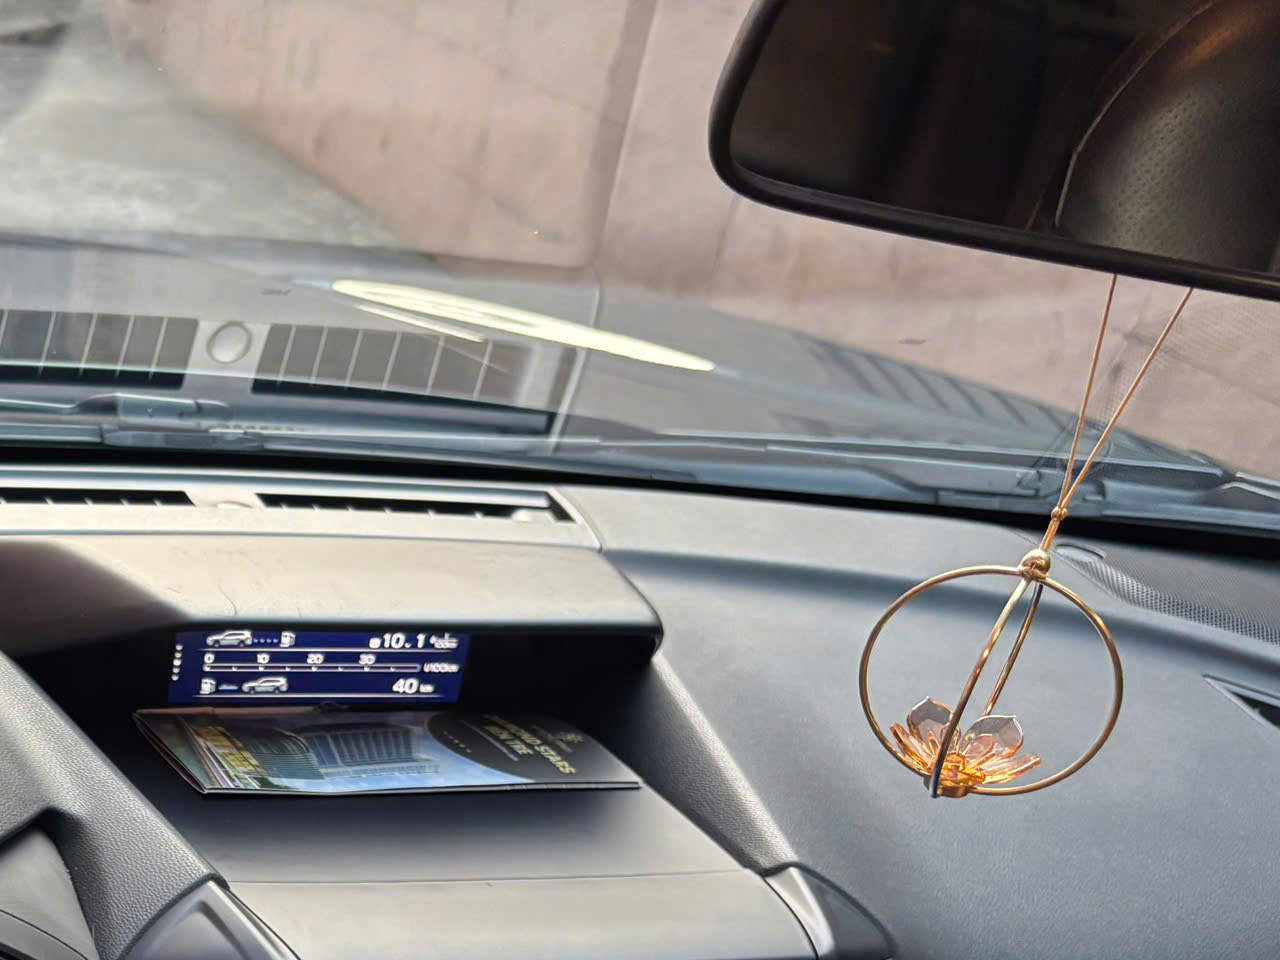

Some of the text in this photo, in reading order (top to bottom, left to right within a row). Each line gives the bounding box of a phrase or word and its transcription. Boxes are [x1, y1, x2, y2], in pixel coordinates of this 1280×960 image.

[257, 653, 269, 664] 10
[307, 653, 324, 664] 20
[358, 653, 376, 665] 30
[392, 678, 419, 693] 40
